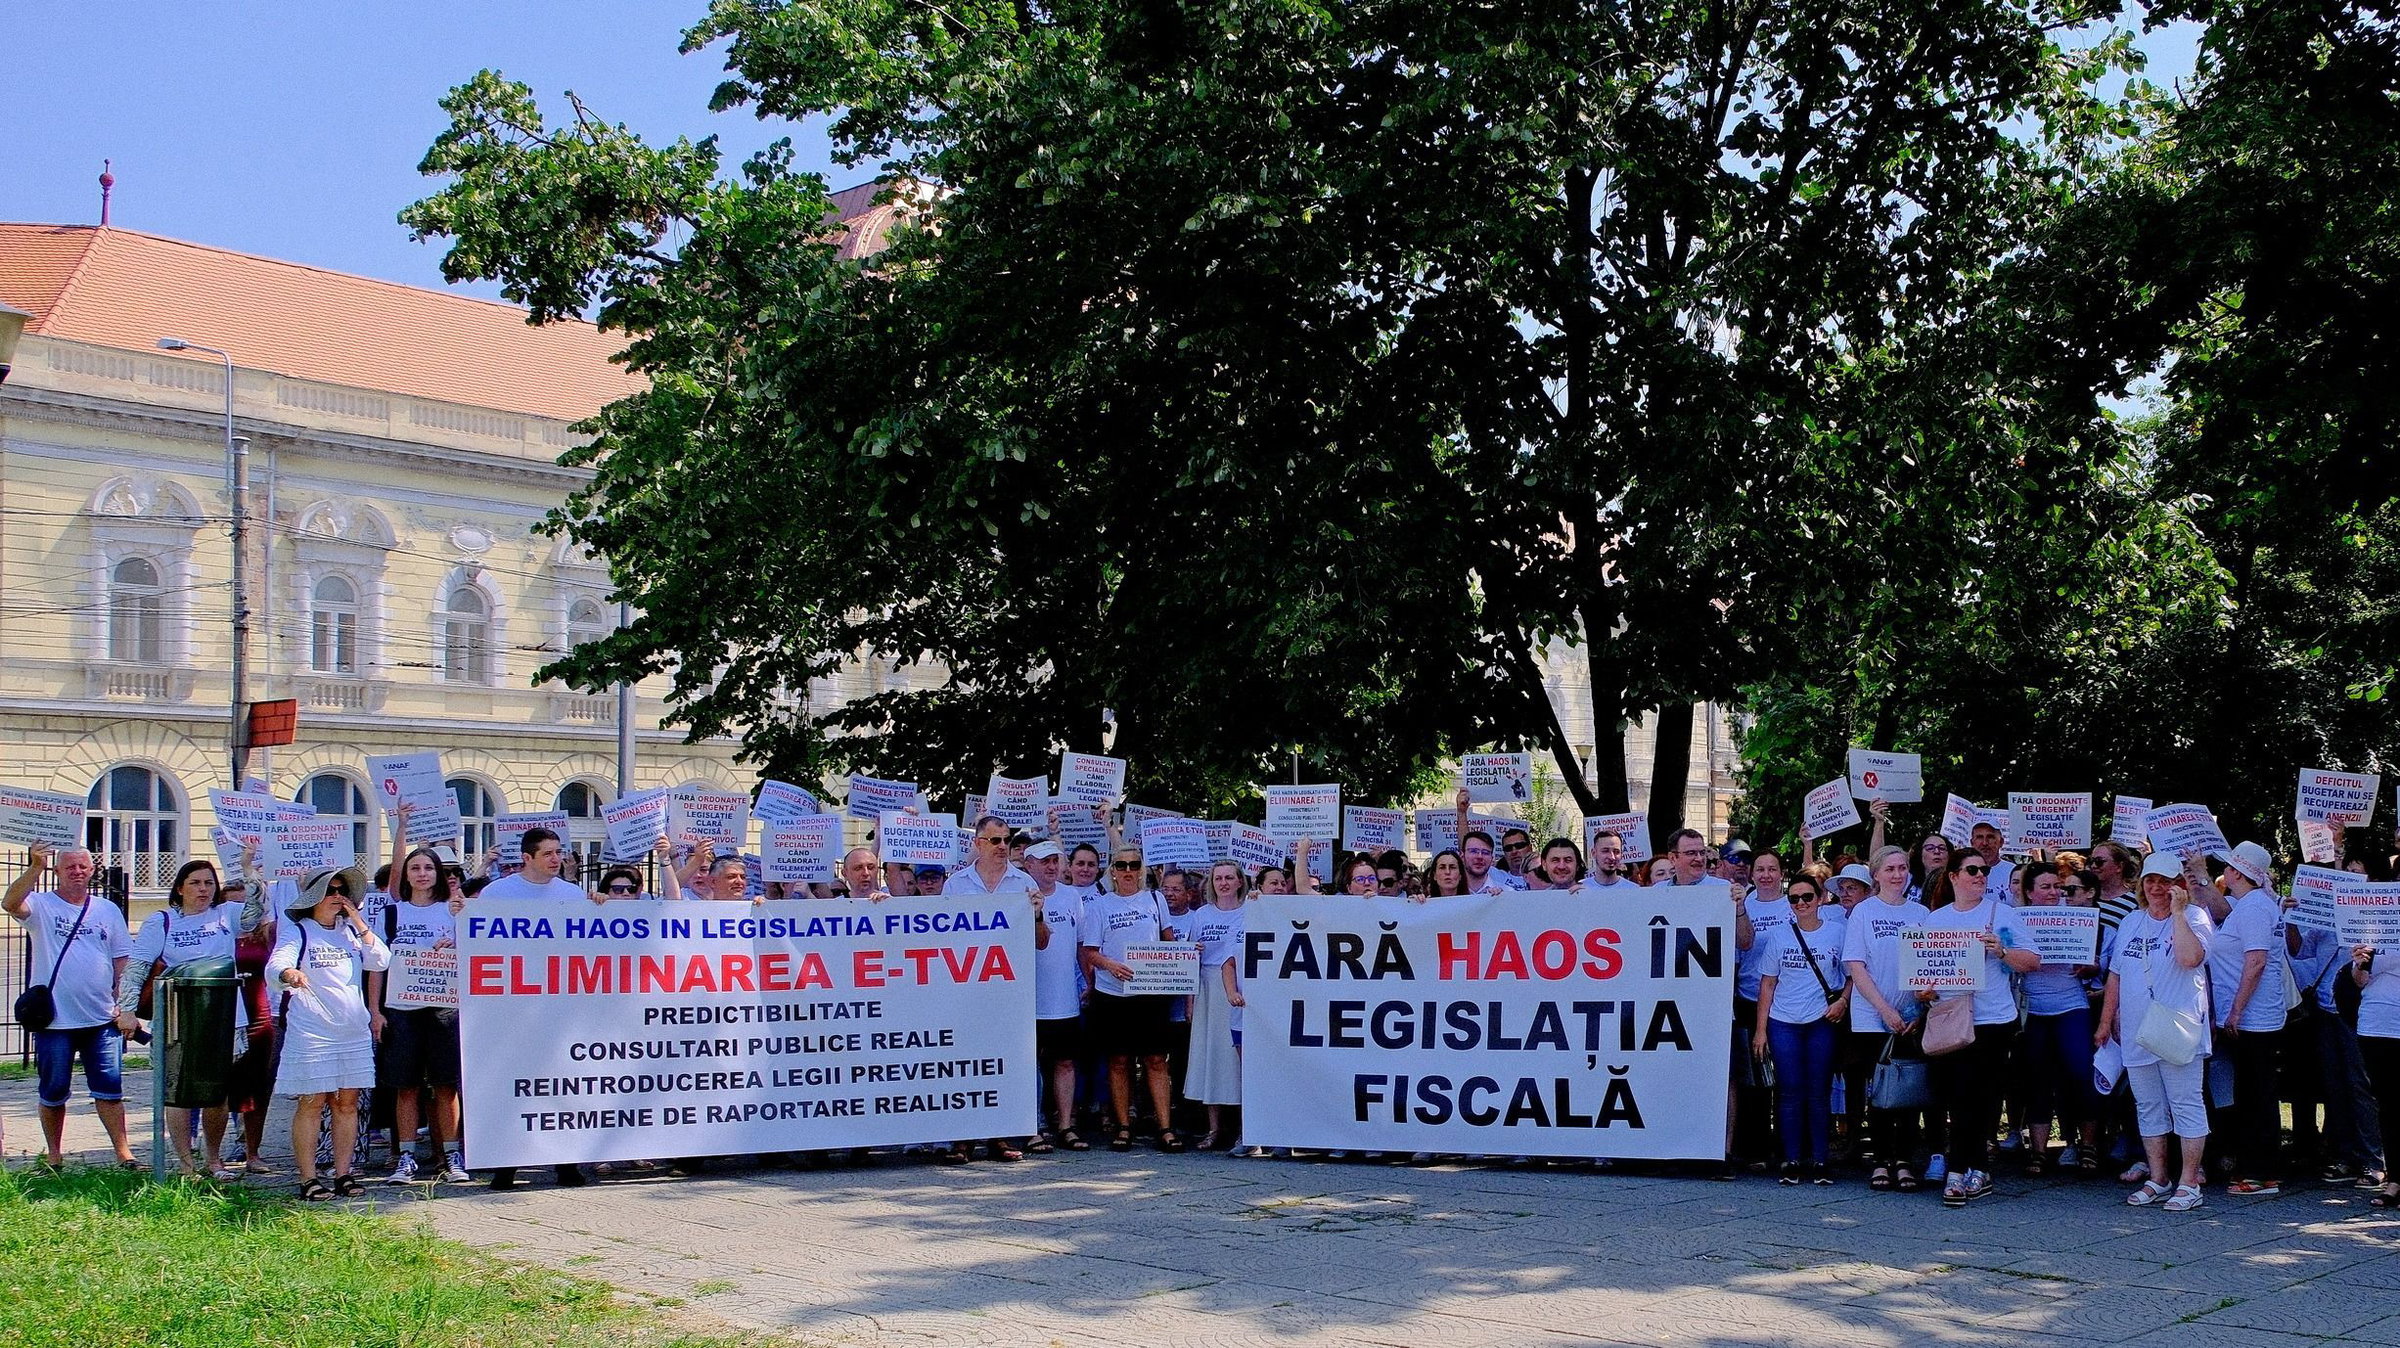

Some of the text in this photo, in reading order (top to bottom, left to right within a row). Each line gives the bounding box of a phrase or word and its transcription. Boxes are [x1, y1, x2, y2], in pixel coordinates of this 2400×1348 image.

[1487, 757, 1510, 766] HAOS
[2315, 776, 2363, 789] DEFICITUL
[852, 783, 892, 798] ELIMINAREA
[893, 789, 914, 799] E-TVA
[2301, 785, 2374, 801] BUGETAR NU SE
[1, 797, 52, 813] ELIMINAREA
[55, 805, 82, 816] E-TVA
[221, 796, 264, 809] DEFICITUL
[1269, 795, 1337, 805] ELIMINAREA E-TVA
[251, 811, 264, 821] NU
[265, 812, 277, 822] SE
[607, 803, 656, 824] ELIMINAREA
[2307, 809, 2324, 819] DIN
[896, 817, 942, 828] DEFICITUL
[2148, 814, 2195, 831] ELIMINAREA
[884, 827, 954, 839] BUGETAR NU SE
[1144, 827, 1184, 837] ELIMINAREA
[892, 849, 908, 858] DIN
[1231, 838, 1284, 859] BUGETAR NU SE
[2296, 877, 2333, 891] ELIMINARE
[2336, 895, 2395, 906] ELIMINAREA
[470, 911, 1010, 939] FARA HAOS IN LEGISLATIA FISCALA
[2026, 917, 2095, 928] IMINAREA E-TVA
[1244, 915, 1722, 981] FĂRĂ HAOS ÎN
[1912, 941, 1924, 949] DE
[1127, 952, 1197, 961] ELIMINAREA E-TVA
[470, 946, 1016, 995] ELIMINAREA E-TVA
[644, 1001, 882, 1025] PREDICTIBILITATE
[1290, 1000, 1694, 1071] LEGISLAȚIA
[570, 1029, 954, 1061] CONSULTARI PUBLICE REALE
[515, 1058, 1004, 1097] REINTRODUCEREA LEGII PREVENTIEI
[1354, 1065, 1646, 1130] FISCALĂ
[521, 1090, 999, 1131] TERMENE DE RAPORTARE REALISTE
